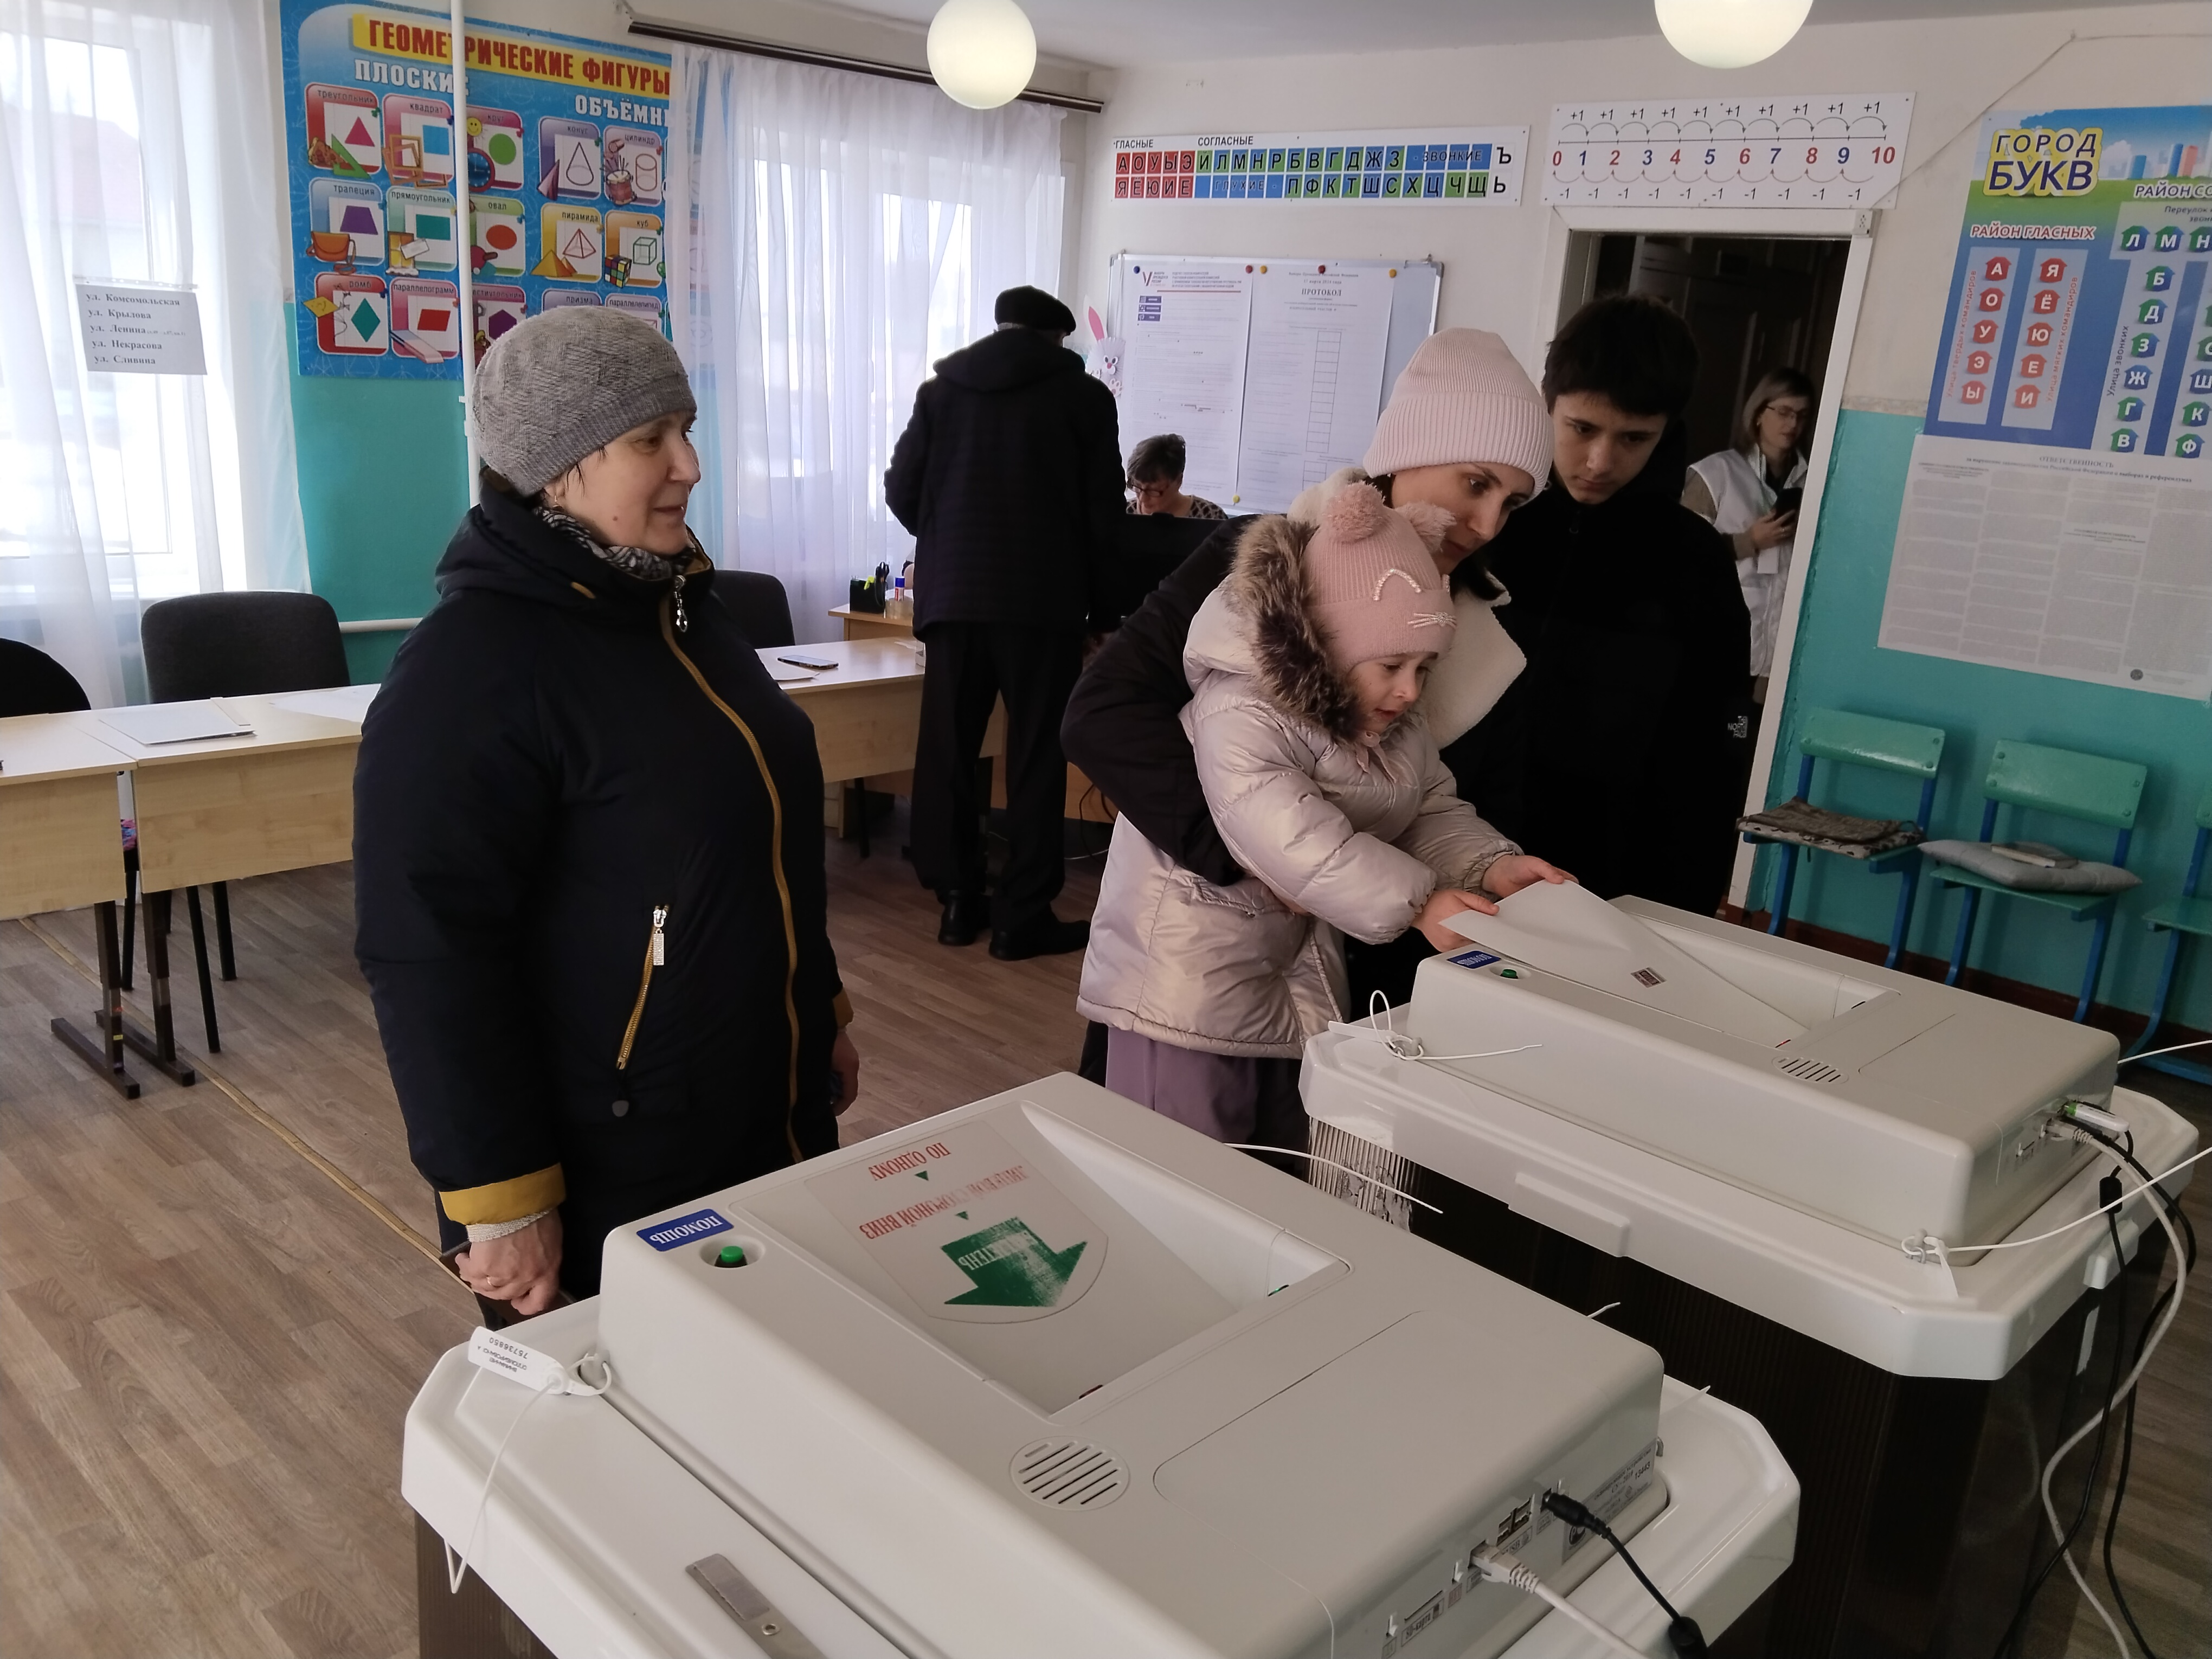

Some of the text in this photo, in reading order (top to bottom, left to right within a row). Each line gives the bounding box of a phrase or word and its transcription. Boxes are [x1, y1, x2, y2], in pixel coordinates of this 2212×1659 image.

[369, 20, 670, 95] ГЕОМЕРИЧЕСКИЕ ФИГУРЫ
[317, 89, 374, 104] треугольник
[409, 102, 443, 113] квадрат
[1571, 101, 1880, 121] +1 +1 +1 +1 +1 +1 +1 +1 +1 +1
[567, 126, 588, 134] конус
[625, 134, 655, 145] цилиндр
[1115, 136, 1253, 149] ГЛАСНЫЕ СОГЛАСНЫЕ
[1996, 133, 2097, 158] ГОРОД
[1118, 146, 1512, 171] А О У Ы Э Й Л М Н Р Б В Г Д Ж З ЗВОНКИЕ Ъ
[1553, 146, 1895, 166] 0 1 2 3 4 5 6 7 8 9 10
[1989, 160, 2093, 191] БУКВ
[333, 184, 375, 195] трапеция
[1118, 176, 1506, 197] Я Ё Ю И Е ГЛУХИЕ П Ф К Т Ш С Х Ц Ч Щ Ь
[2136, 182, 2191, 196] РАЙОН
[391, 191, 451, 203] прямоугольник
[488, 202, 507, 210] овал
[2164, 205, 2208, 215] Переулок
[562, 211, 599, 223] пирамида
[636, 220, 649, 228] куб
[1971, 222, 2095, 239] РАЙОН ГЛАСНЫХ
[2126, 234, 2210, 248] Л М Н
[349, 280, 371, 289] ромб
[393, 283, 455, 294] параллелограмм
[86, 293, 180, 306] ул. Комсомольская
[565, 296, 593, 304] призма
[609, 299, 659, 310] параллелепипед
[1961, 271, 1976, 327] командиров
[88, 308, 151, 319] ул. Крылова
[90, 325, 104, 333] ул.
[110, 325, 146, 334] Ленина
[1966, 262, 2003, 399] А О У Э Ы
[2021, 264, 2059, 404] Я Ё Ю Е И
[92, 339, 162, 350] ул. Некрасова
[2046, 276, 2078, 402] Улица мягких командиров
[94, 356, 108, 364] ул.
[2107, 325, 2129, 396] Улица звонких
[2117, 272, 2165, 448] Б Д З Ж Г В
[2191, 408, 2204, 421] К
[2182, 439, 2196, 454] Ф
[2039, 456, 2114, 468] ОТВЕТСТВЕННОСТЬ
[868, 1142, 951, 1181] ПО ОДНОМУ
[650, 1216, 723, 1244] ПОМОЩЬ
[859, 1214, 902, 1239] ВНИЗ
[489, 1337, 529, 1359] 75736850
